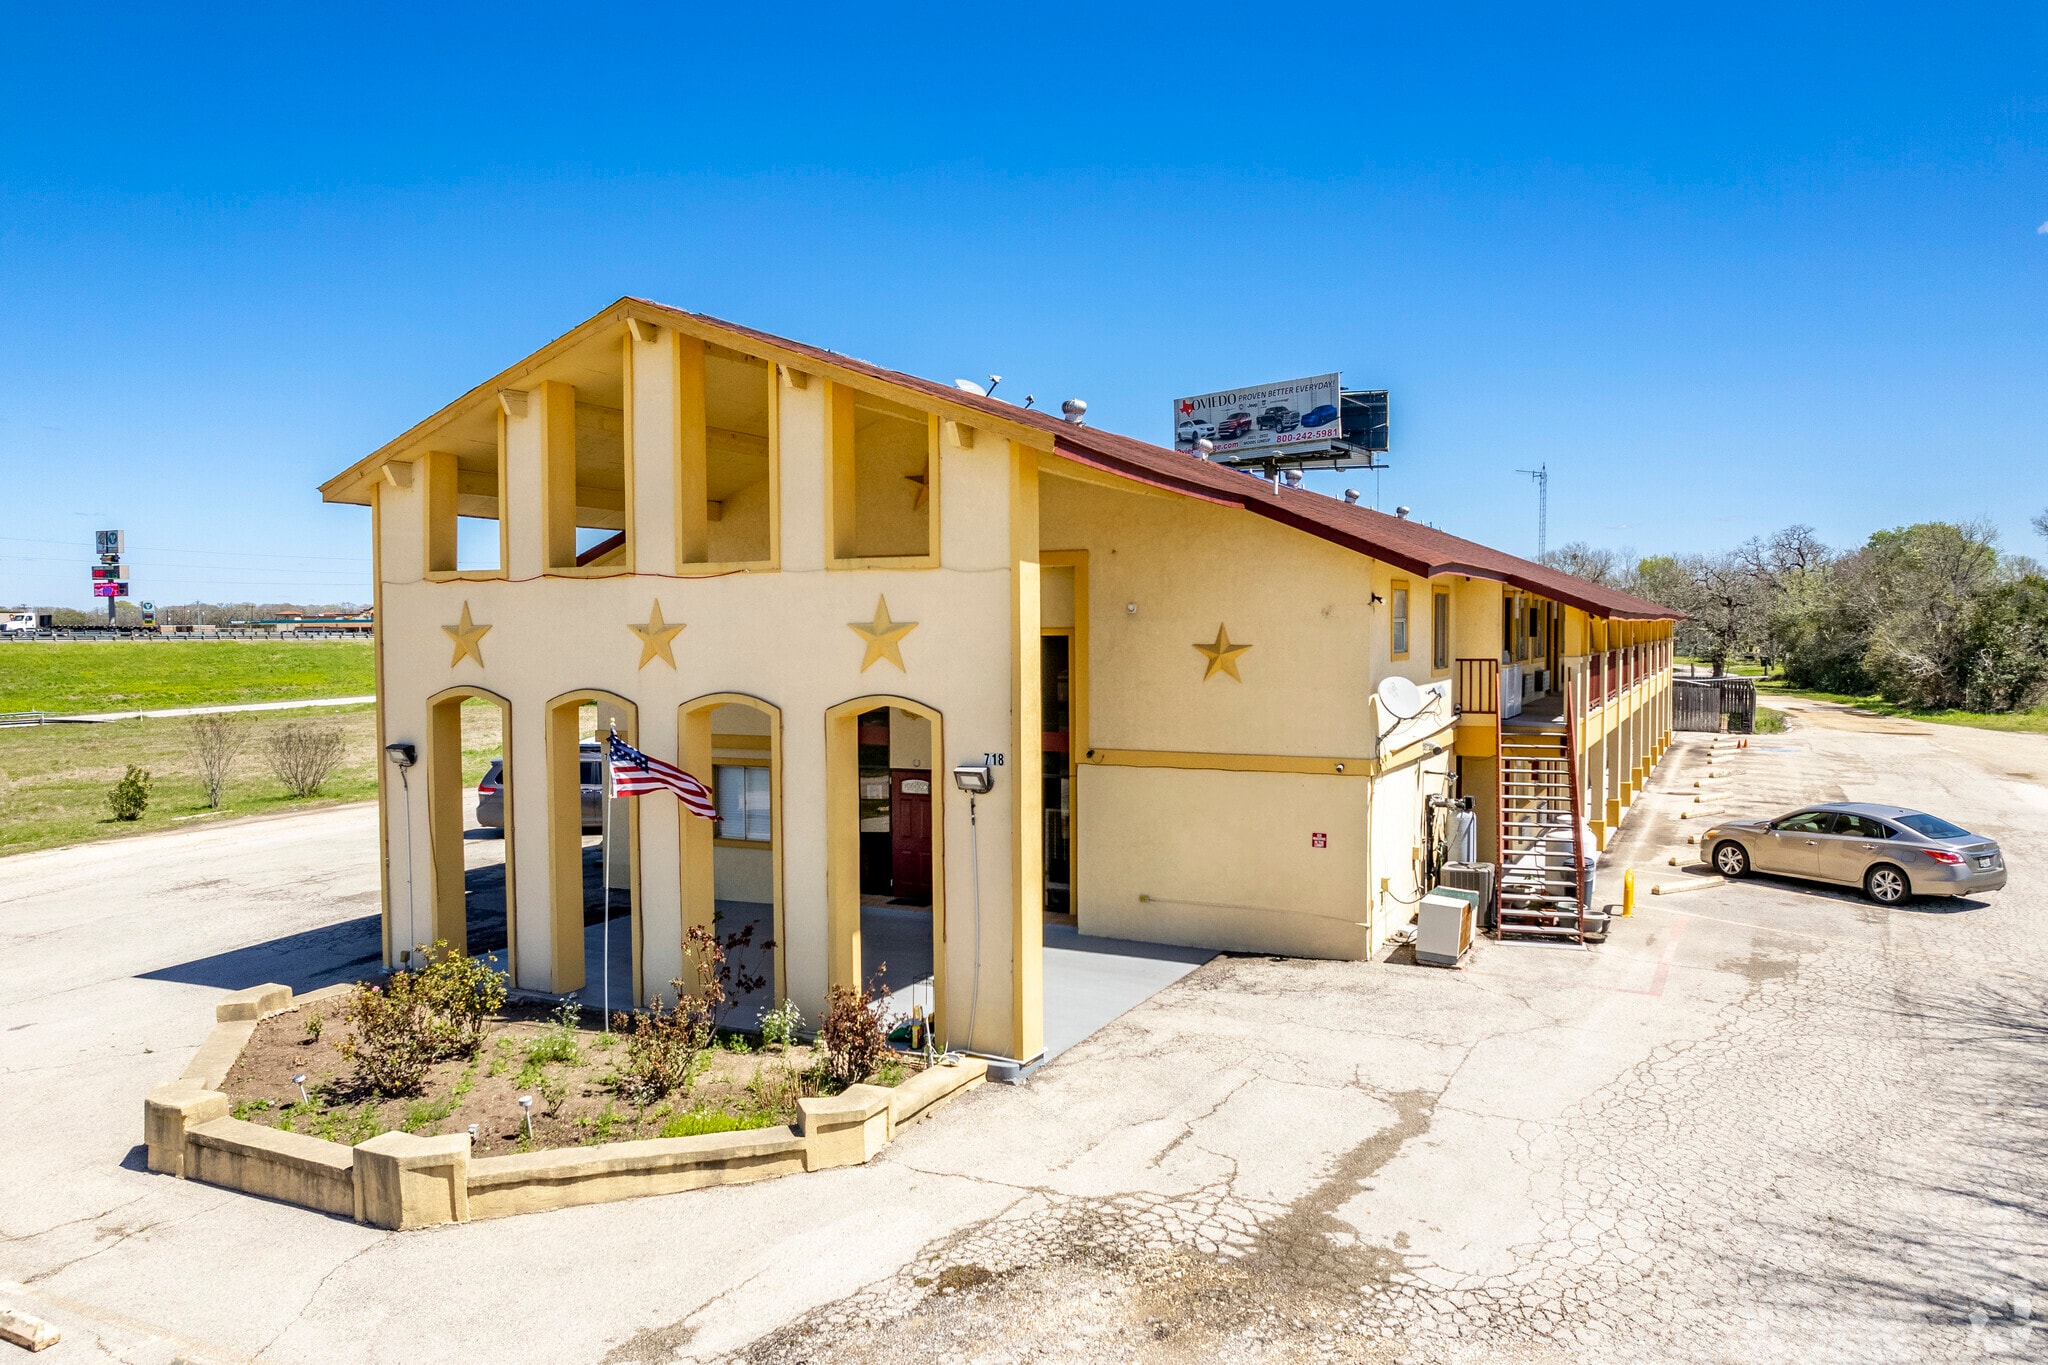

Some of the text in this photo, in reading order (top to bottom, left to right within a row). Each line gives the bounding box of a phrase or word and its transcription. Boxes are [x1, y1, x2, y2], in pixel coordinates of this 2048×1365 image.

[1192, 393, 1237, 411] OVIEDO
[1238, 391, 1267, 402] PROVEN
[1268, 387, 1294, 397] BETTER
[1295, 380, 1336, 393] EVERYDAY!
[1276, 428, 1338, 443] 800-242-5981
[984, 753, 1004, 766] 718
